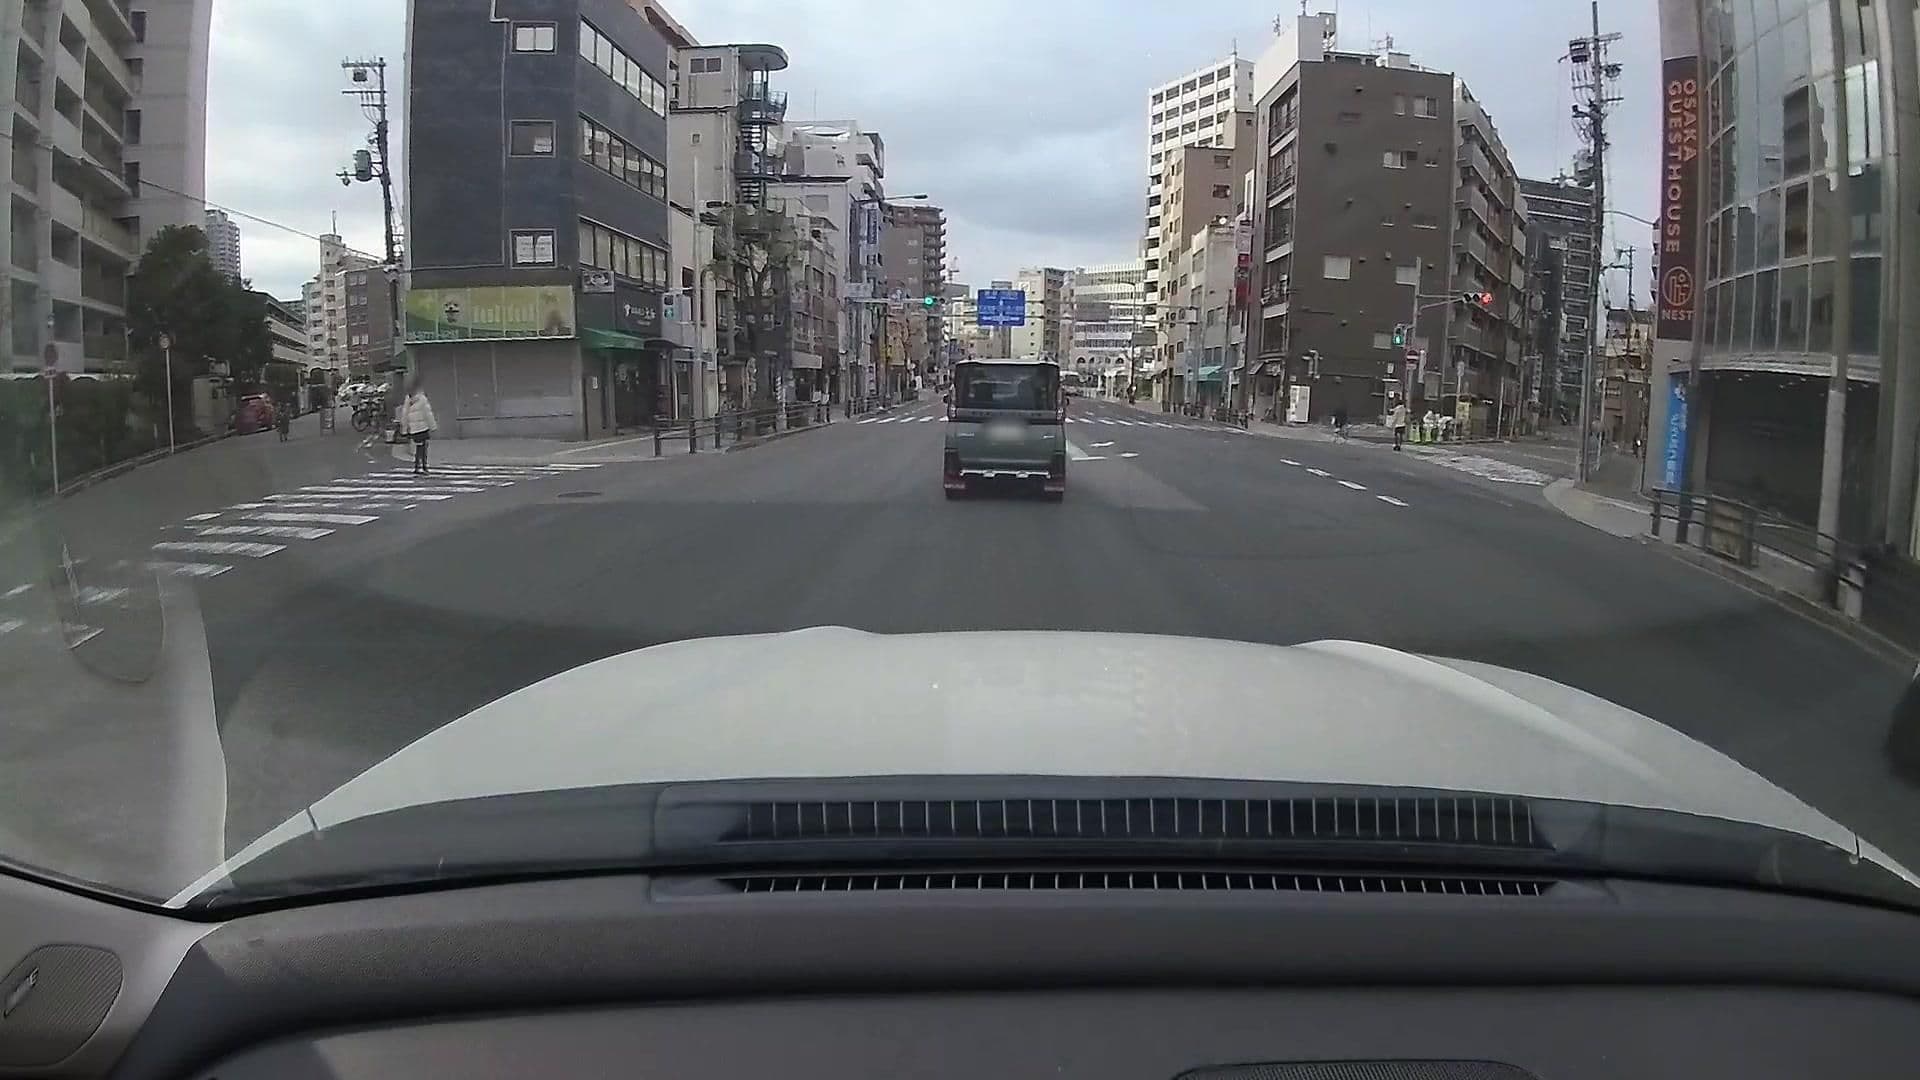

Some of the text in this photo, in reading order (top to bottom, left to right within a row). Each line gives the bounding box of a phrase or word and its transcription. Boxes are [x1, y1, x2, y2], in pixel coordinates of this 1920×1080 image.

[1683, 80, 1697, 162] OSAKA
[1665, 80, 1682, 253] GUESTHOUSE
[1662, 310, 1694, 321] NEST
